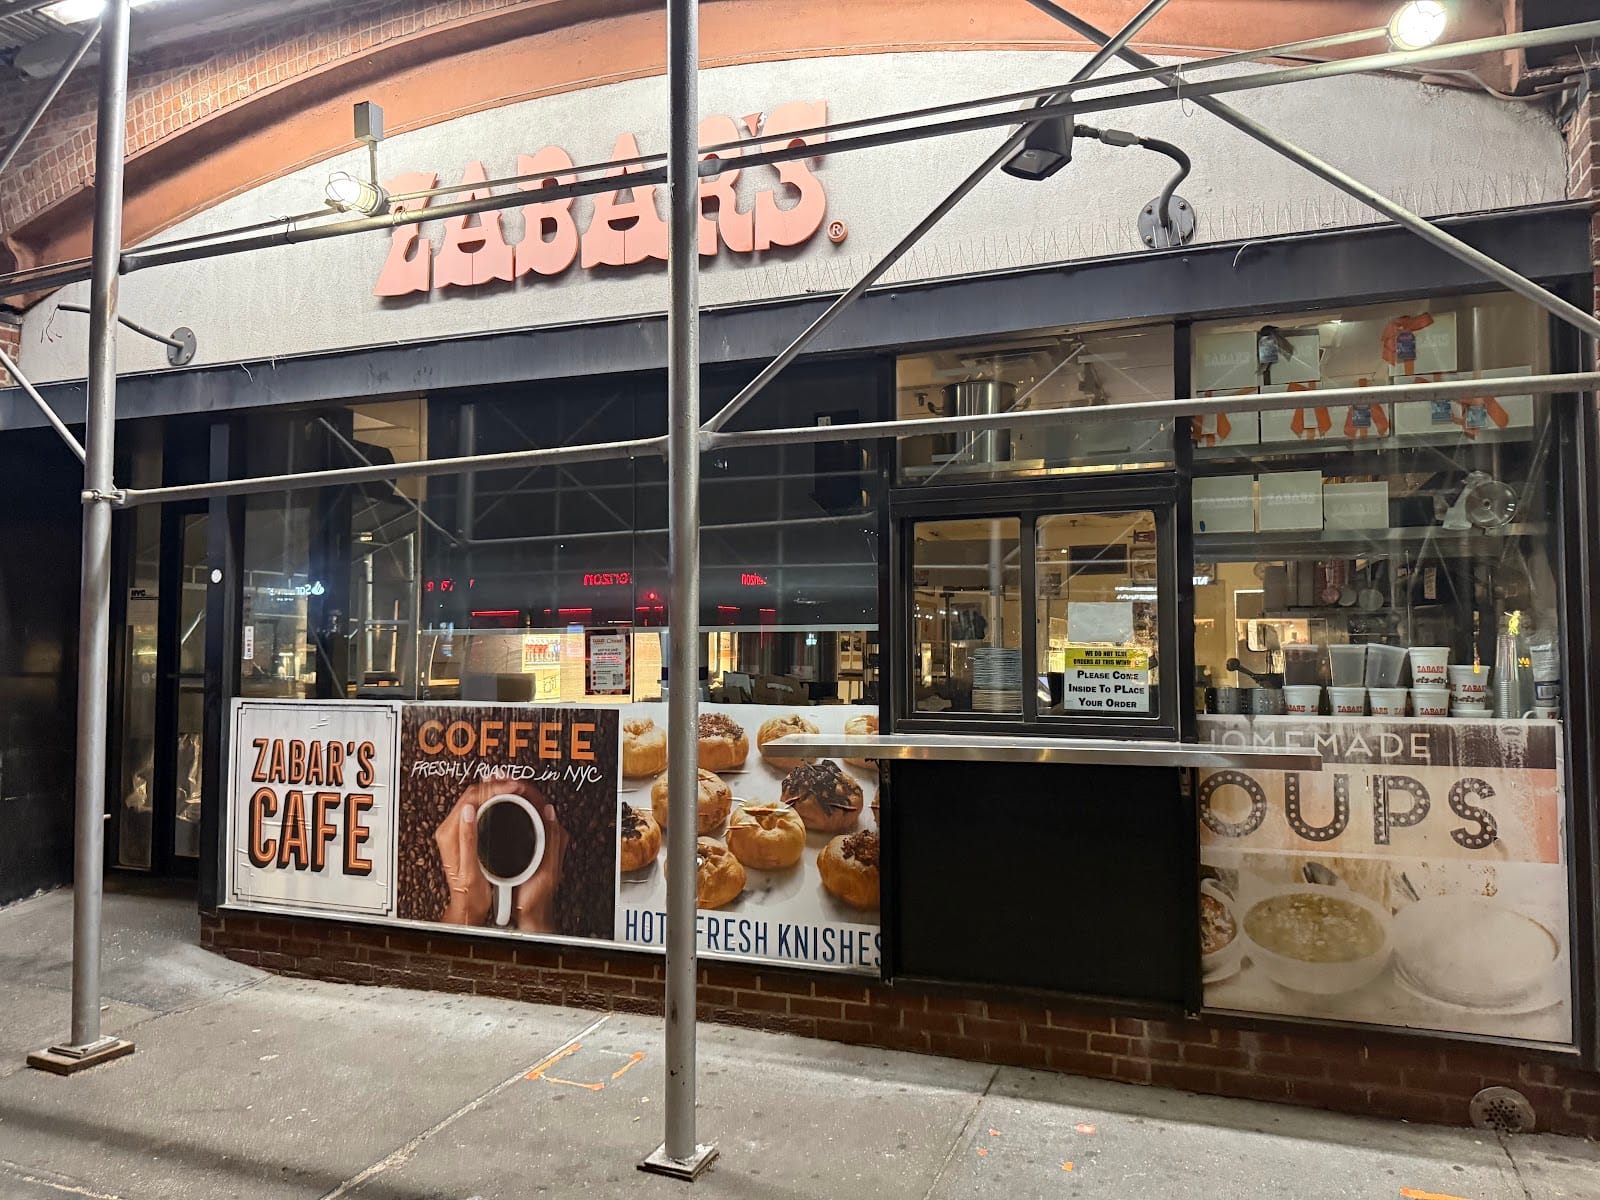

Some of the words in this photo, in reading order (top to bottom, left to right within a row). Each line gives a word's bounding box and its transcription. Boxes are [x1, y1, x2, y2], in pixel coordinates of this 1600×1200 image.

[418, 721, 596, 761] COFFEE
[251, 738, 376, 789] ZABAR'S
[410, 760, 474, 784] FRESHLY
[473, 762, 535, 782] ROASTED
[533, 765, 561, 782] in
[563, 765, 603, 791] NYC
[248, 787, 373, 876] CAFE
[625, 909, 667, 944] HOT
